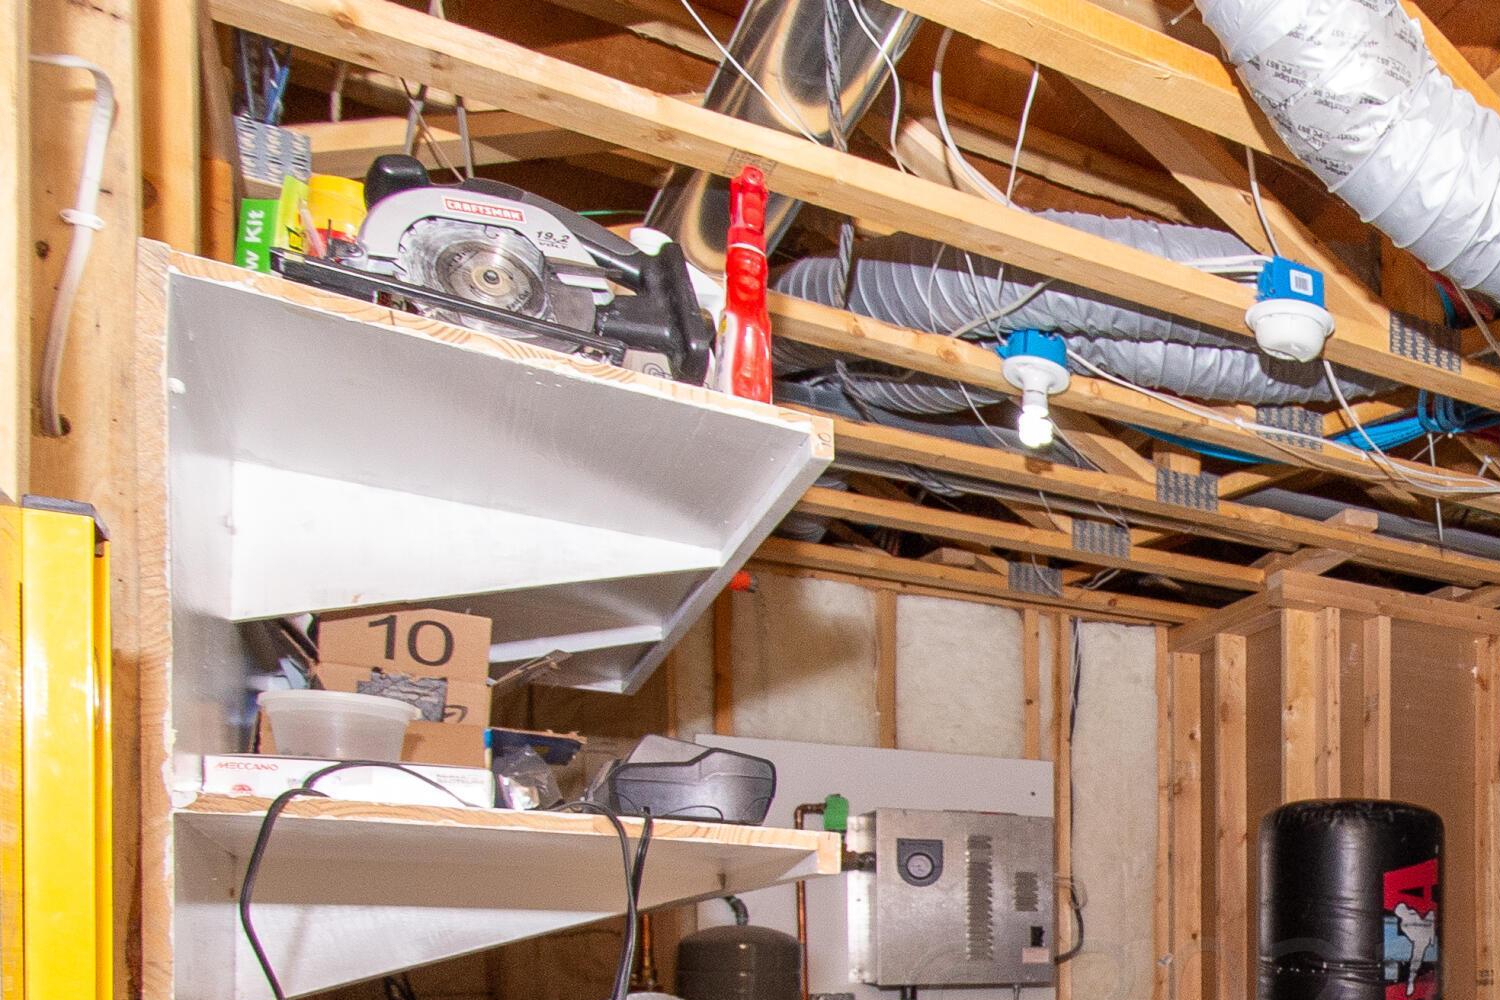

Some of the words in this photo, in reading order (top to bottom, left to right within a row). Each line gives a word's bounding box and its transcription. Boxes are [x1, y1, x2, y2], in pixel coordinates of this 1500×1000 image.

[445, 199, 524, 222] CRAFTSMAN
[243, 208, 264, 243] Kit
[536, 230, 571, 245] 19.2
[368, 614, 455, 667] 10
[215, 761, 279, 772] MECCANO
